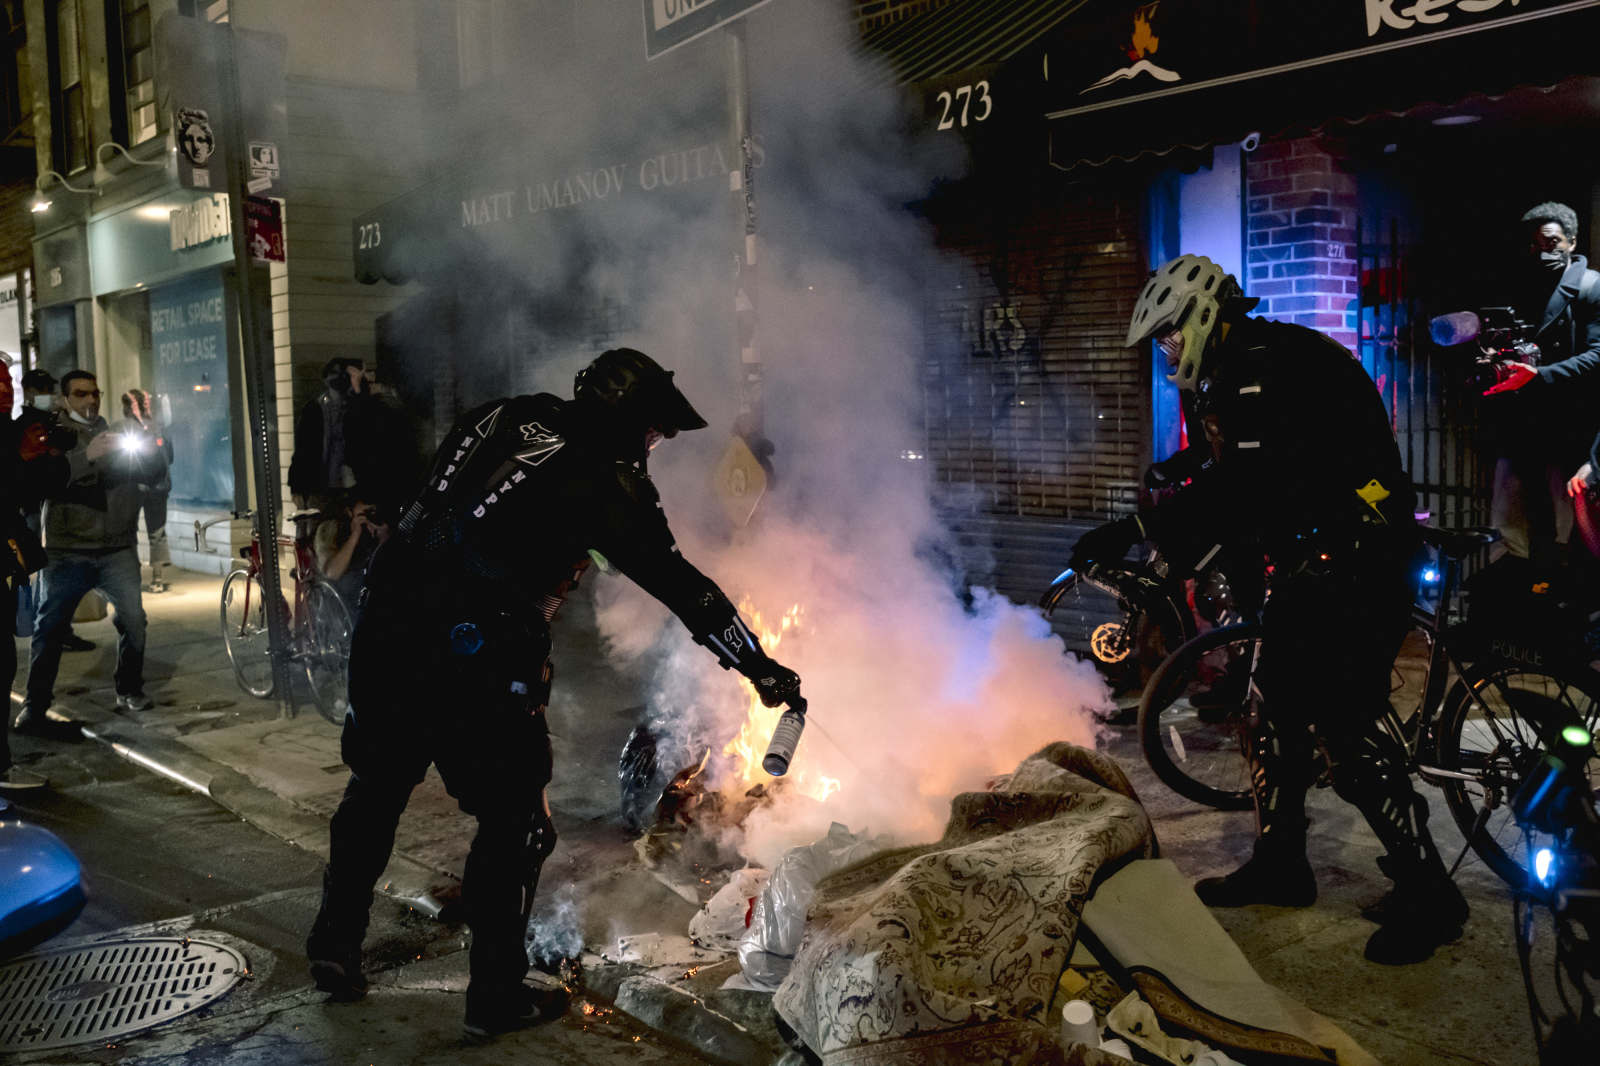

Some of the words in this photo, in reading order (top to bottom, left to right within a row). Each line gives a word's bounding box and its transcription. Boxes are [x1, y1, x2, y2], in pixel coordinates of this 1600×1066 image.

[936, 80, 992, 131] 273
[461, 191, 515, 227] MATT
[525, 164, 628, 213] UMANOV
[639, 135, 766, 191] GUITAS
[359, 221, 381, 249] 273
[152, 306, 186, 333] RETAIL
[187, 297, 223, 327] SPACE
[160, 341, 182, 368] FOR
[183, 335, 217, 362] LEASE
[437, 436, 474, 492] NYPD
[473, 470, 527, 518] NYPD
[1491, 638, 1545, 666] POLICE
